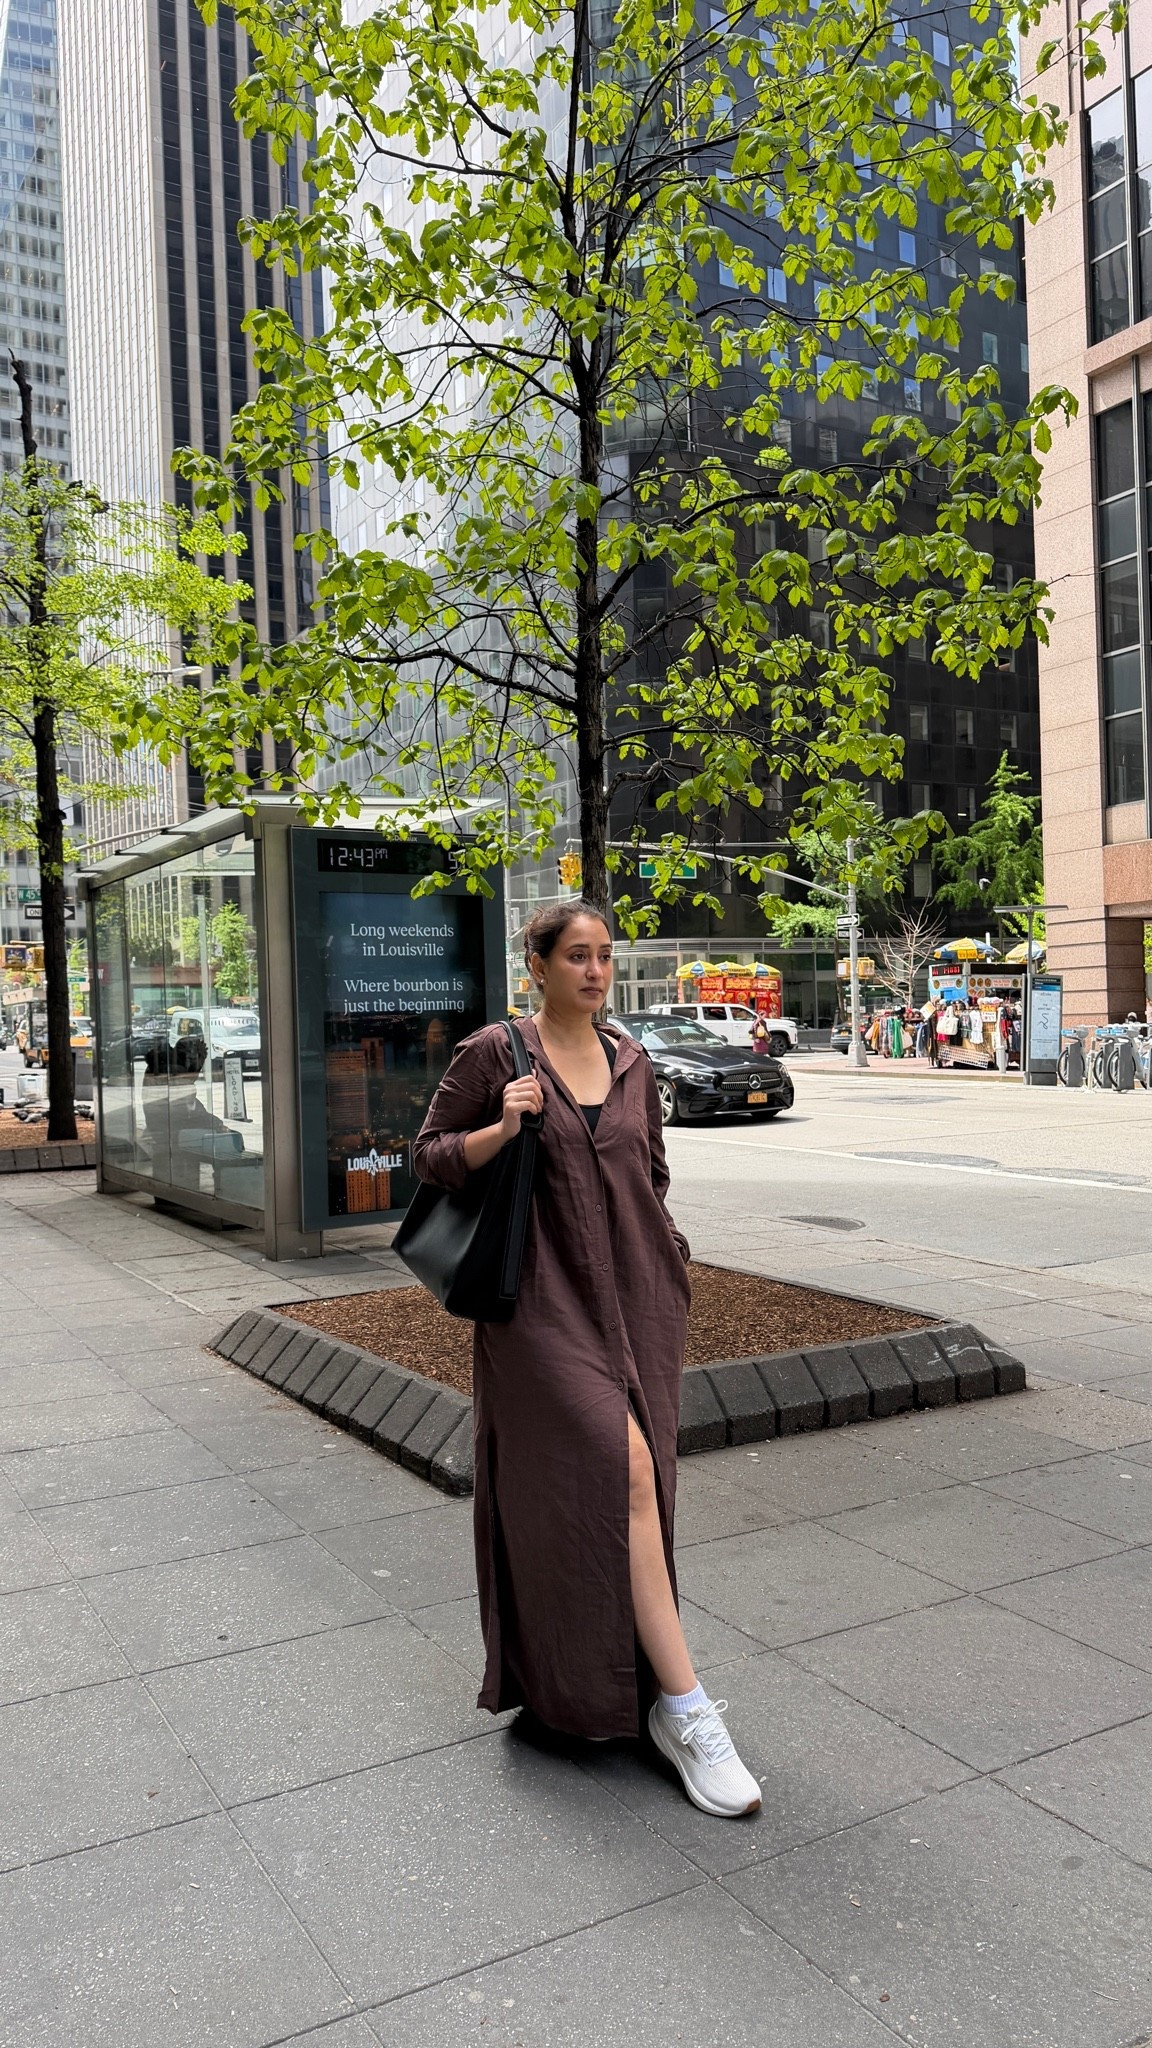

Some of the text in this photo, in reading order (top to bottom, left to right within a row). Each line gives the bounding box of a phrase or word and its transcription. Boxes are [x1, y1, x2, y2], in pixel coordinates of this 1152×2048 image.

[18, 890, 24, 899] W
[26, 890, 36, 900] 45
[350, 923, 455, 939] Long weekends
[363, 943, 445, 957] in Louisville
[344, 977, 464, 992] Where bourbon is
[343, 996, 465, 1015] just the beginning
